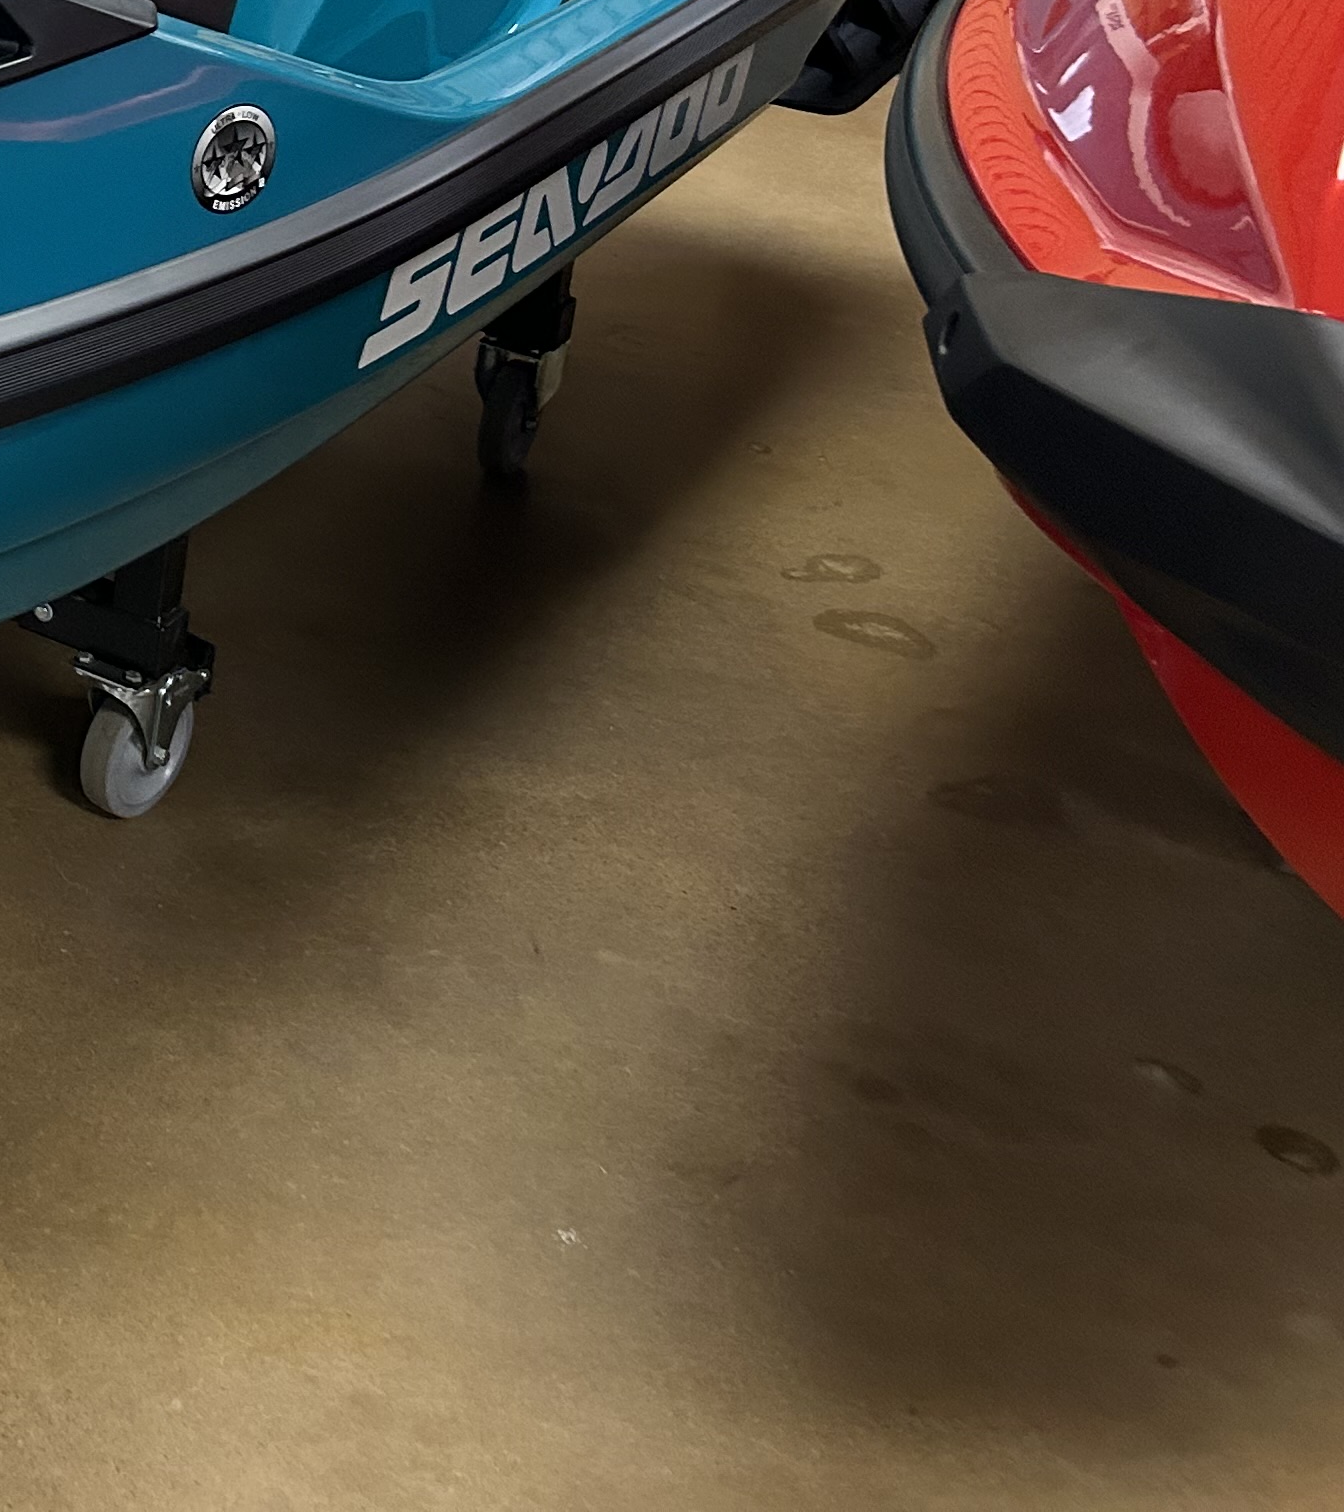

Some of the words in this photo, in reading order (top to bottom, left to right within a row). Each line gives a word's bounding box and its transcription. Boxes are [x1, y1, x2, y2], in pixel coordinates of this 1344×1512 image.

[211, 111, 236, 135] ULTRA
[241, 110, 260, 122] LOW
[212, 186, 257, 211] EMISSION
